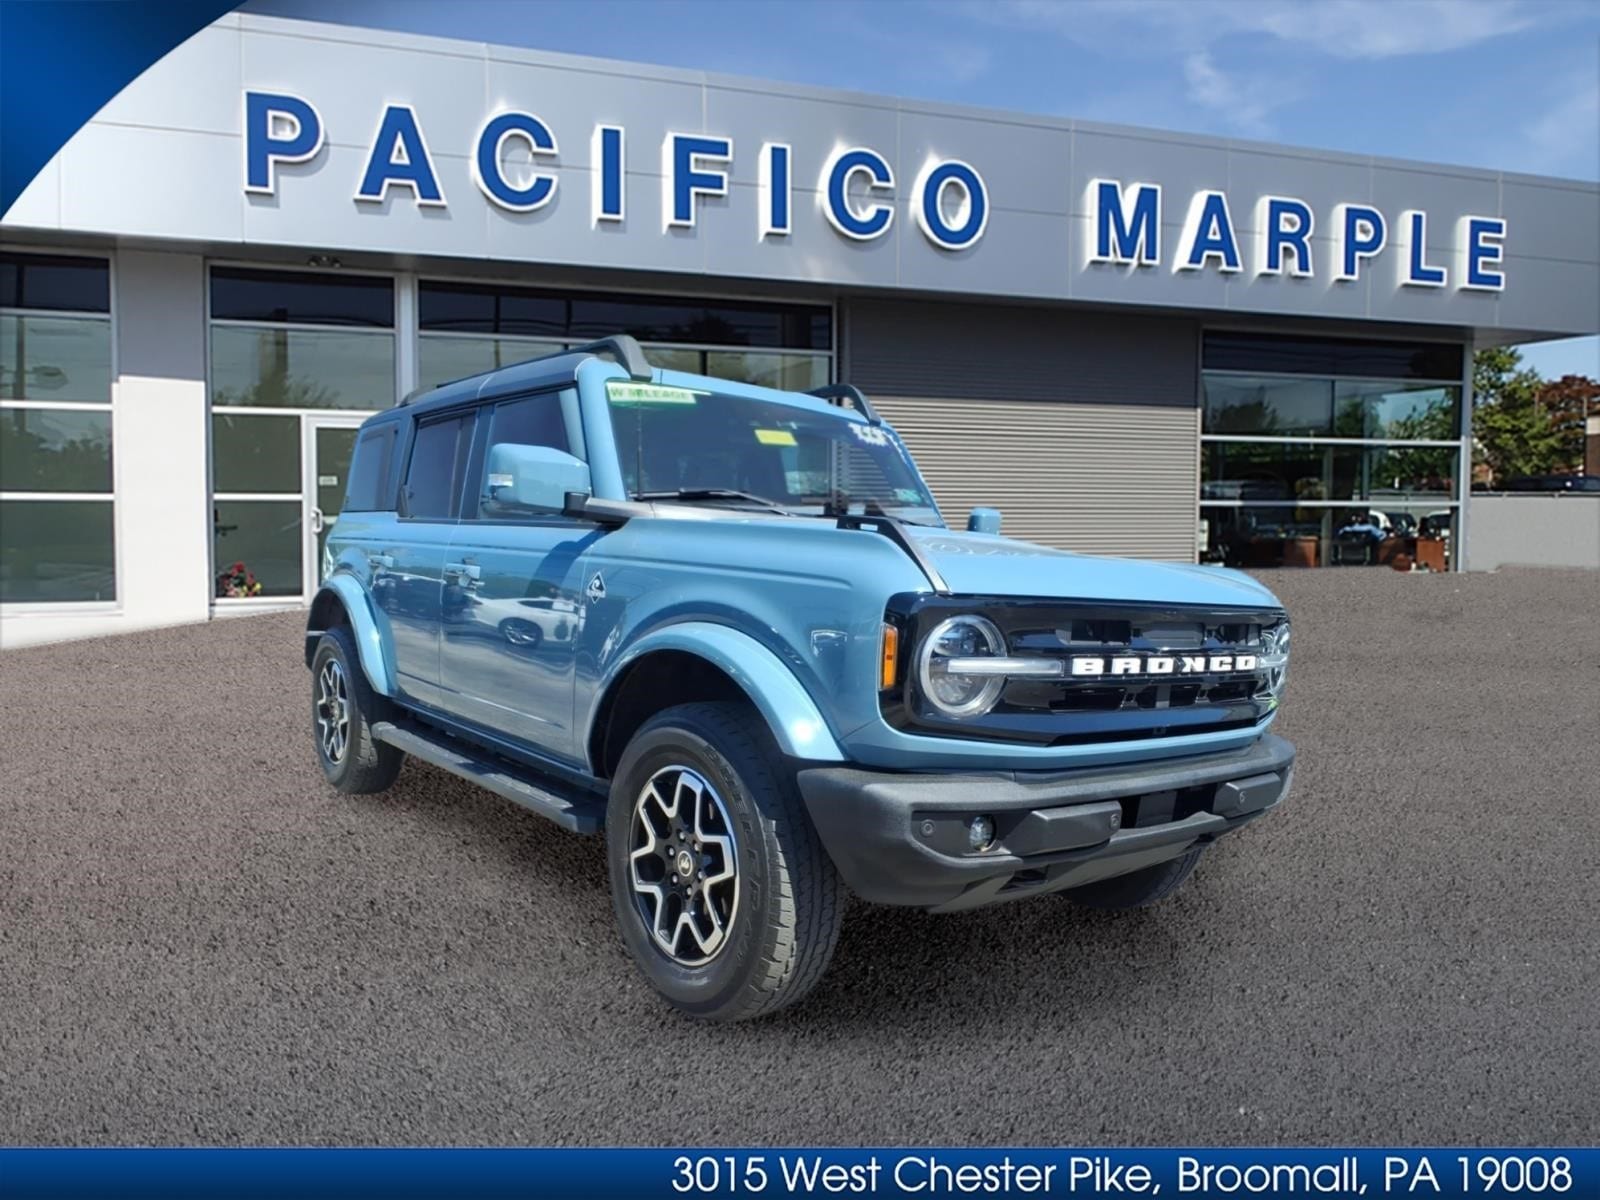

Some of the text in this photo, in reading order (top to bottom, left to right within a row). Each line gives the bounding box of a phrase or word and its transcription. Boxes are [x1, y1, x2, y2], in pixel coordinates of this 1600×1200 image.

[243, 90, 1507, 292] PACIFICO MARPLE
[1071, 656, 1257, 676] BRONCO
